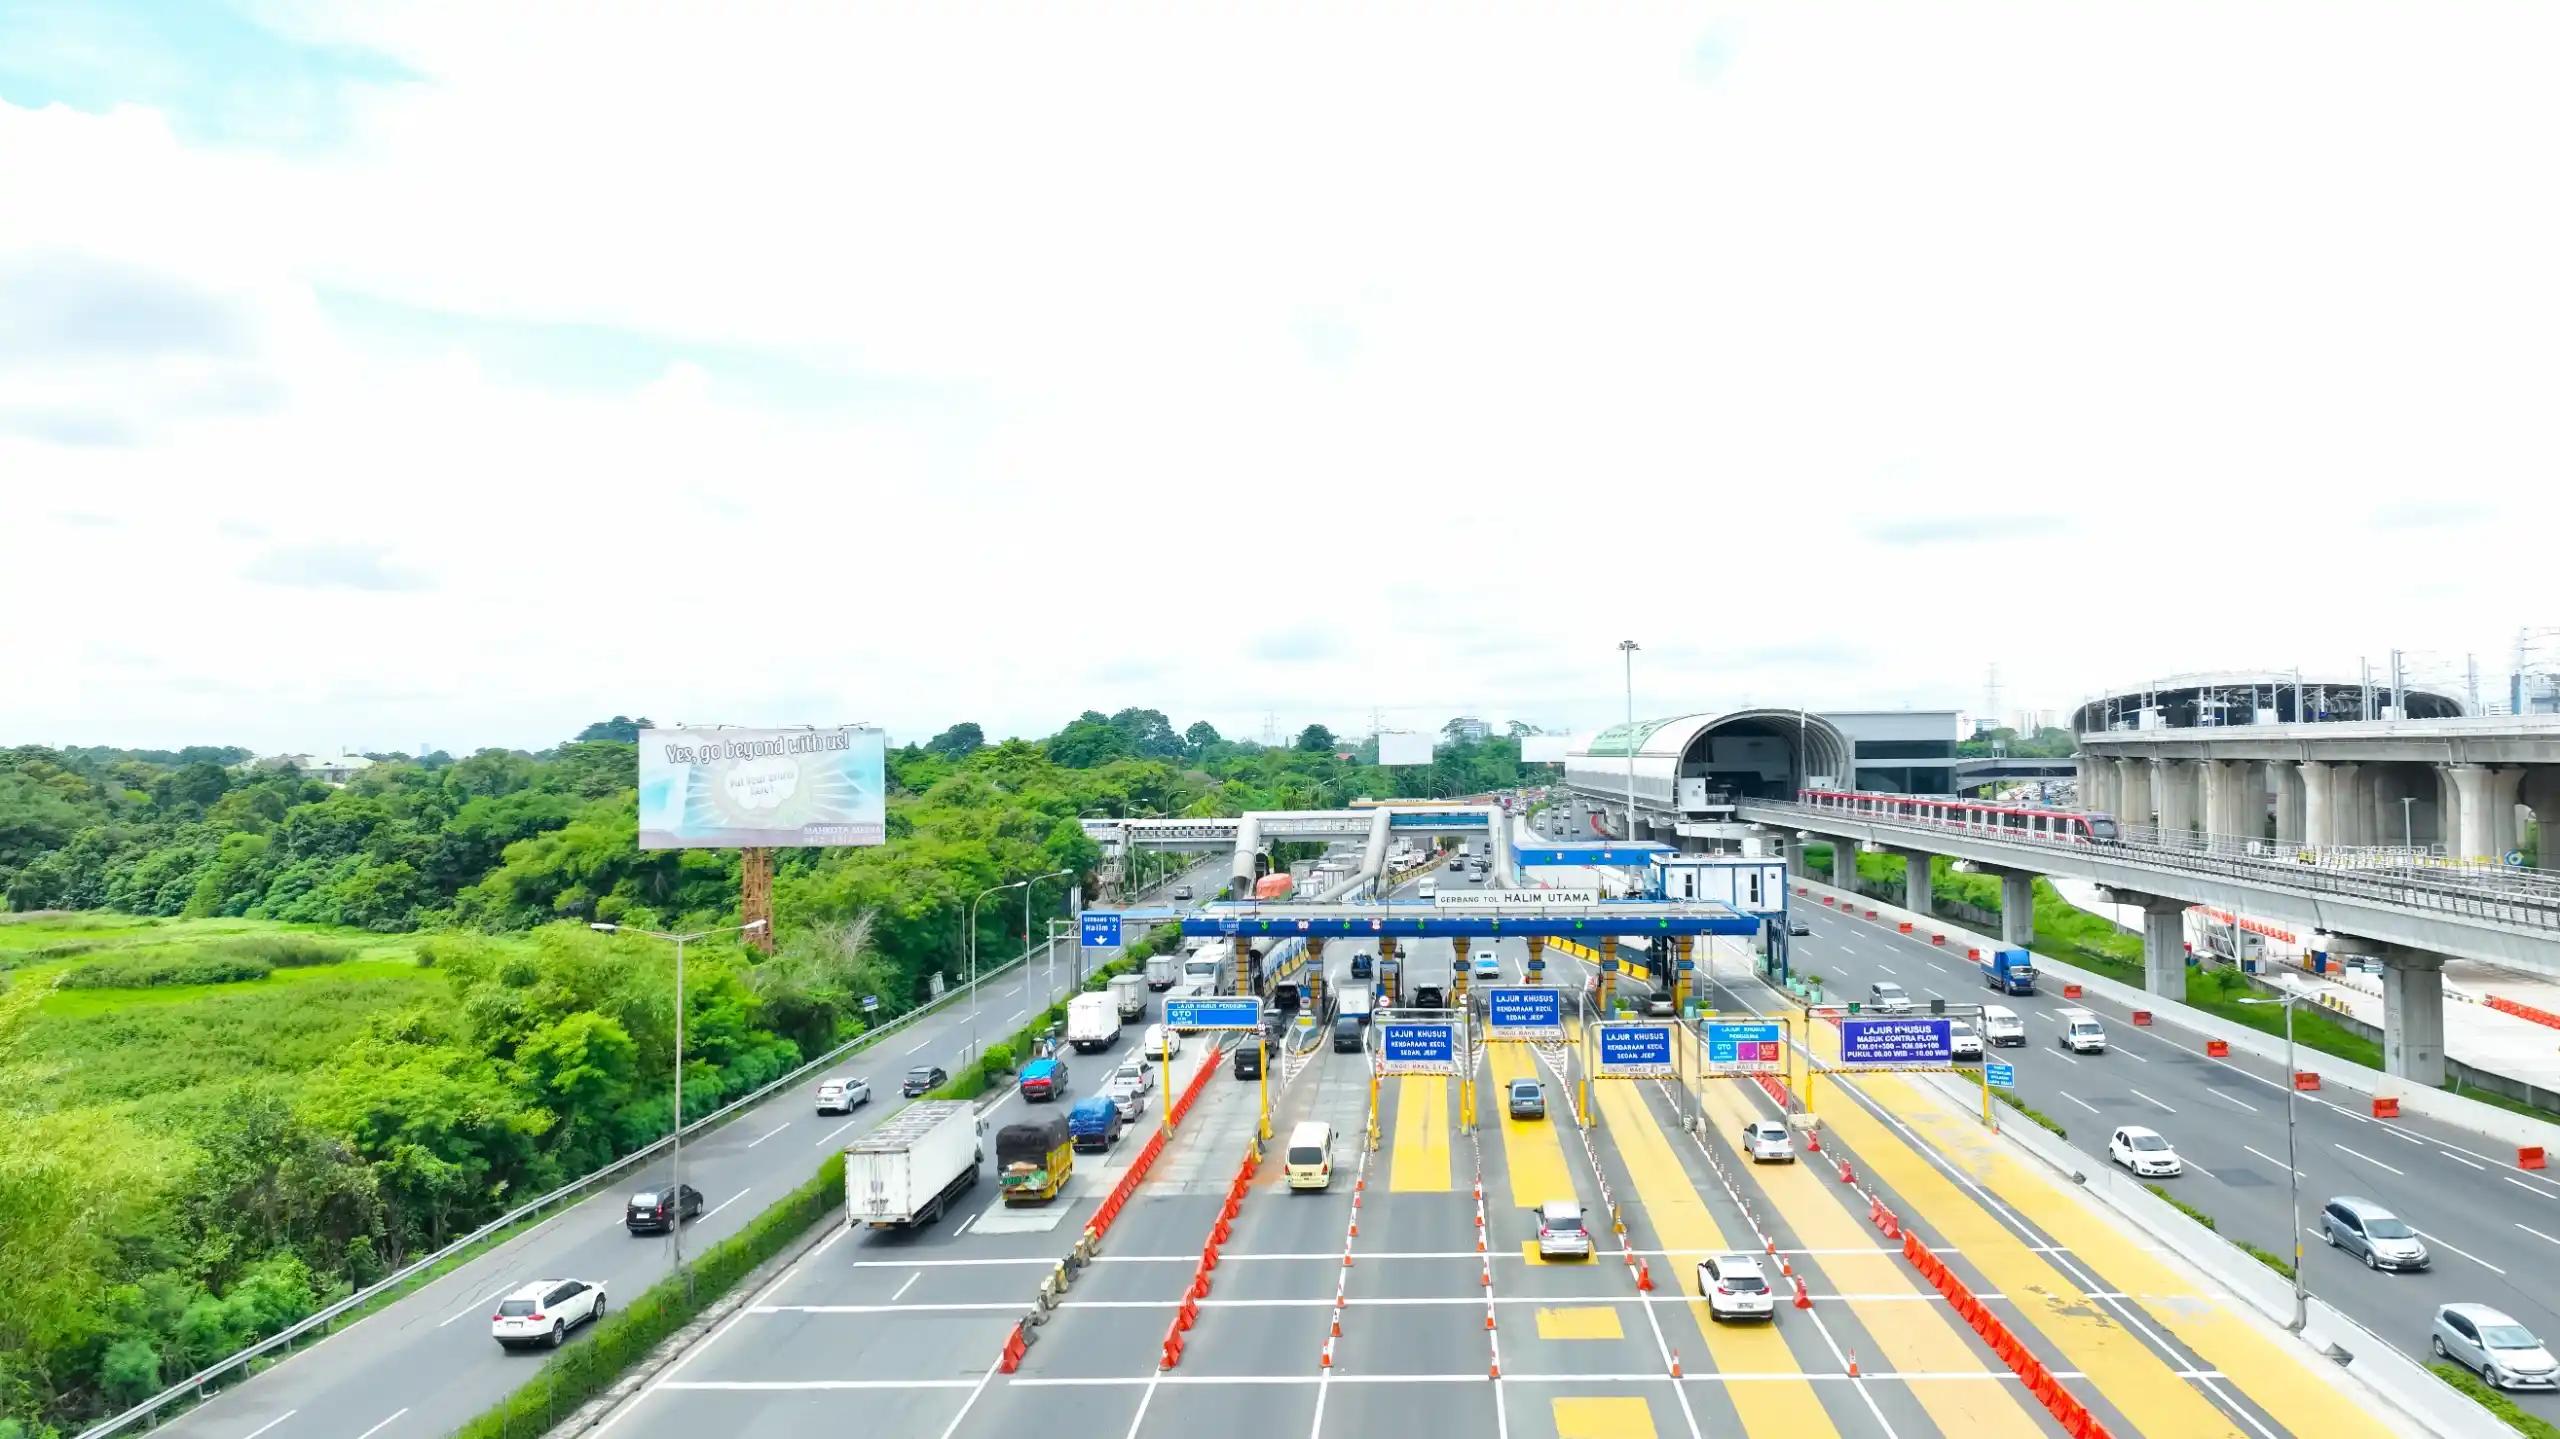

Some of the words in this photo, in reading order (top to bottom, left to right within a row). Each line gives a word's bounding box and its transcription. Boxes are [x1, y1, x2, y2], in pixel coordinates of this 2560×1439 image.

[666, 744, 697, 764] Yes,
[700, 744, 720, 764] go
[724, 736, 784, 760] beyond
[788, 734, 823, 753] with
[826, 731, 850, 750] us!
[1504, 893, 1542, 903] HALIM
[1548, 893, 1590, 902] UTAMA
[1390, 1030, 1413, 1038] LAJUR
[1418, 1030, 1446, 1038] KHUSUS
[1895, 1025, 1931, 1034] KHUSUS
